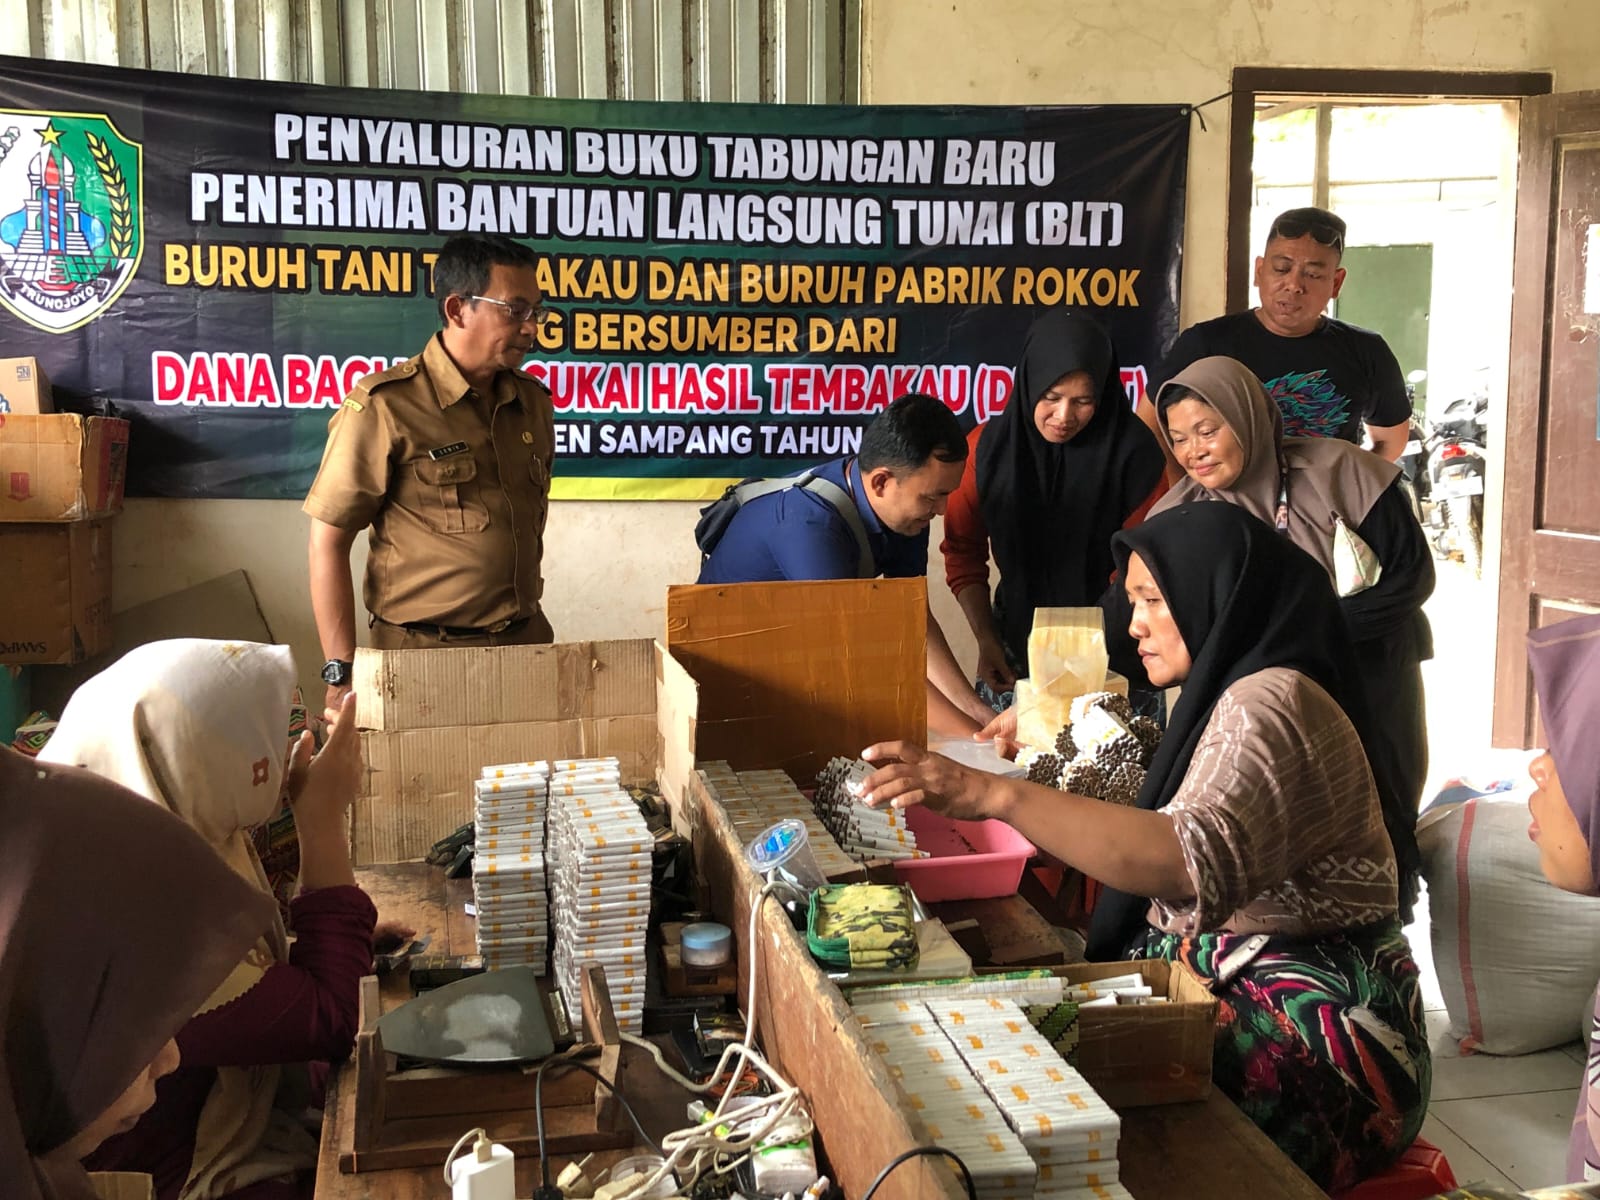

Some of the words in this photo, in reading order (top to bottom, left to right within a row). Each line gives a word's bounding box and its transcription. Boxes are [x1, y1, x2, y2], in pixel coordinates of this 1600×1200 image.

[274, 113, 563, 171] PENYALURAN
[575, 132, 697, 177] BUKU
[707, 136, 935, 184] TABUNGAN
[943, 139, 1055, 187] BARU
[191, 172, 427, 230] PENERIMA
[437, 183, 645, 238] BANTUAN
[656, 192, 882, 245] LANGSUNG
[892, 199, 1015, 246] TUNAI
[1025, 201, 1123, 247] (BLT)
[20, 283, 95, 309] TRUNOJOYO
[165, 245, 305, 290] BURUH
[317, 249, 412, 292] TANI
[649, 261, 729, 301] DAN
[741, 264, 865, 304] BURUH
[875, 266, 1004, 304] PABRIK
[1013, 267, 1139, 306] ROKOK
[574, 313, 797, 352] BERSUMBER
[809, 317, 896, 353] DARI
[155, 354, 278, 405] DANA
[650, 364, 759, 413] HASIL
[599, 424, 752, 454] SAMPANG
[760, 425, 863, 455] TAHUN
